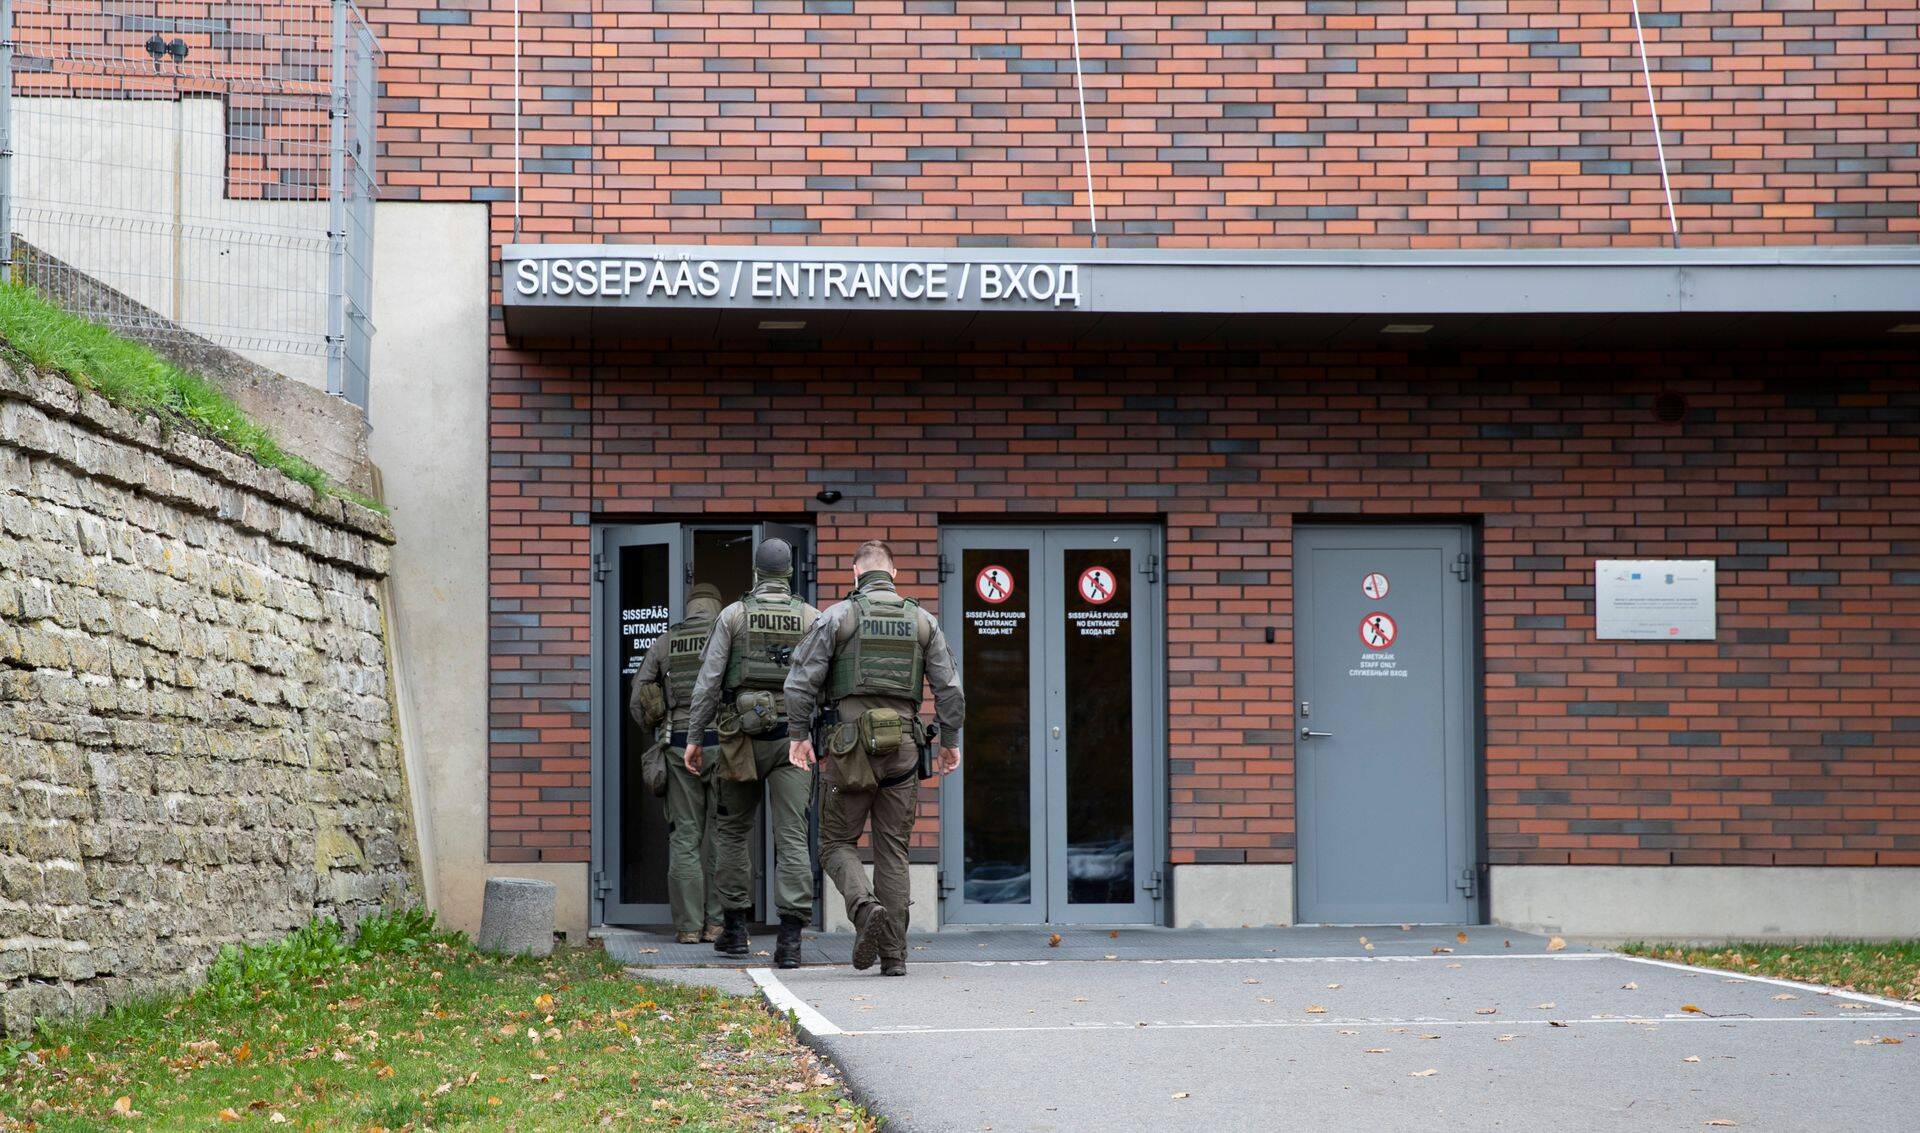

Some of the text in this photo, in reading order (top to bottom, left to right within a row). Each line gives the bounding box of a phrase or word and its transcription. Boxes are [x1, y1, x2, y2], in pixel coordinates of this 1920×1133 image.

[516, 253, 720, 297] SISSEPÄÄS
[752, 261, 948, 299] ENTRANCE
[979, 264, 1081, 306] ВХОД
[622, 606, 669, 620] SISSEPÄÄS
[965, 610, 1000, 619] SISSEPÄÄS
[1067, 610, 1102, 619] SISSEPÄÄS
[750, 613, 801, 632] POLITSEI
[863, 619, 912, 637] POLITSE
[1087, 620, 1120, 628] ENTRANCE
[623, 622, 668, 635] ENTRANCE
[978, 627, 1014, 636] ВХОДА НЕТ
[1080, 628, 1116, 637] ВХОДА НЕТ
[670, 635, 708, 653] POLITS
[1360, 661, 1397, 669] STAFF ONLY
